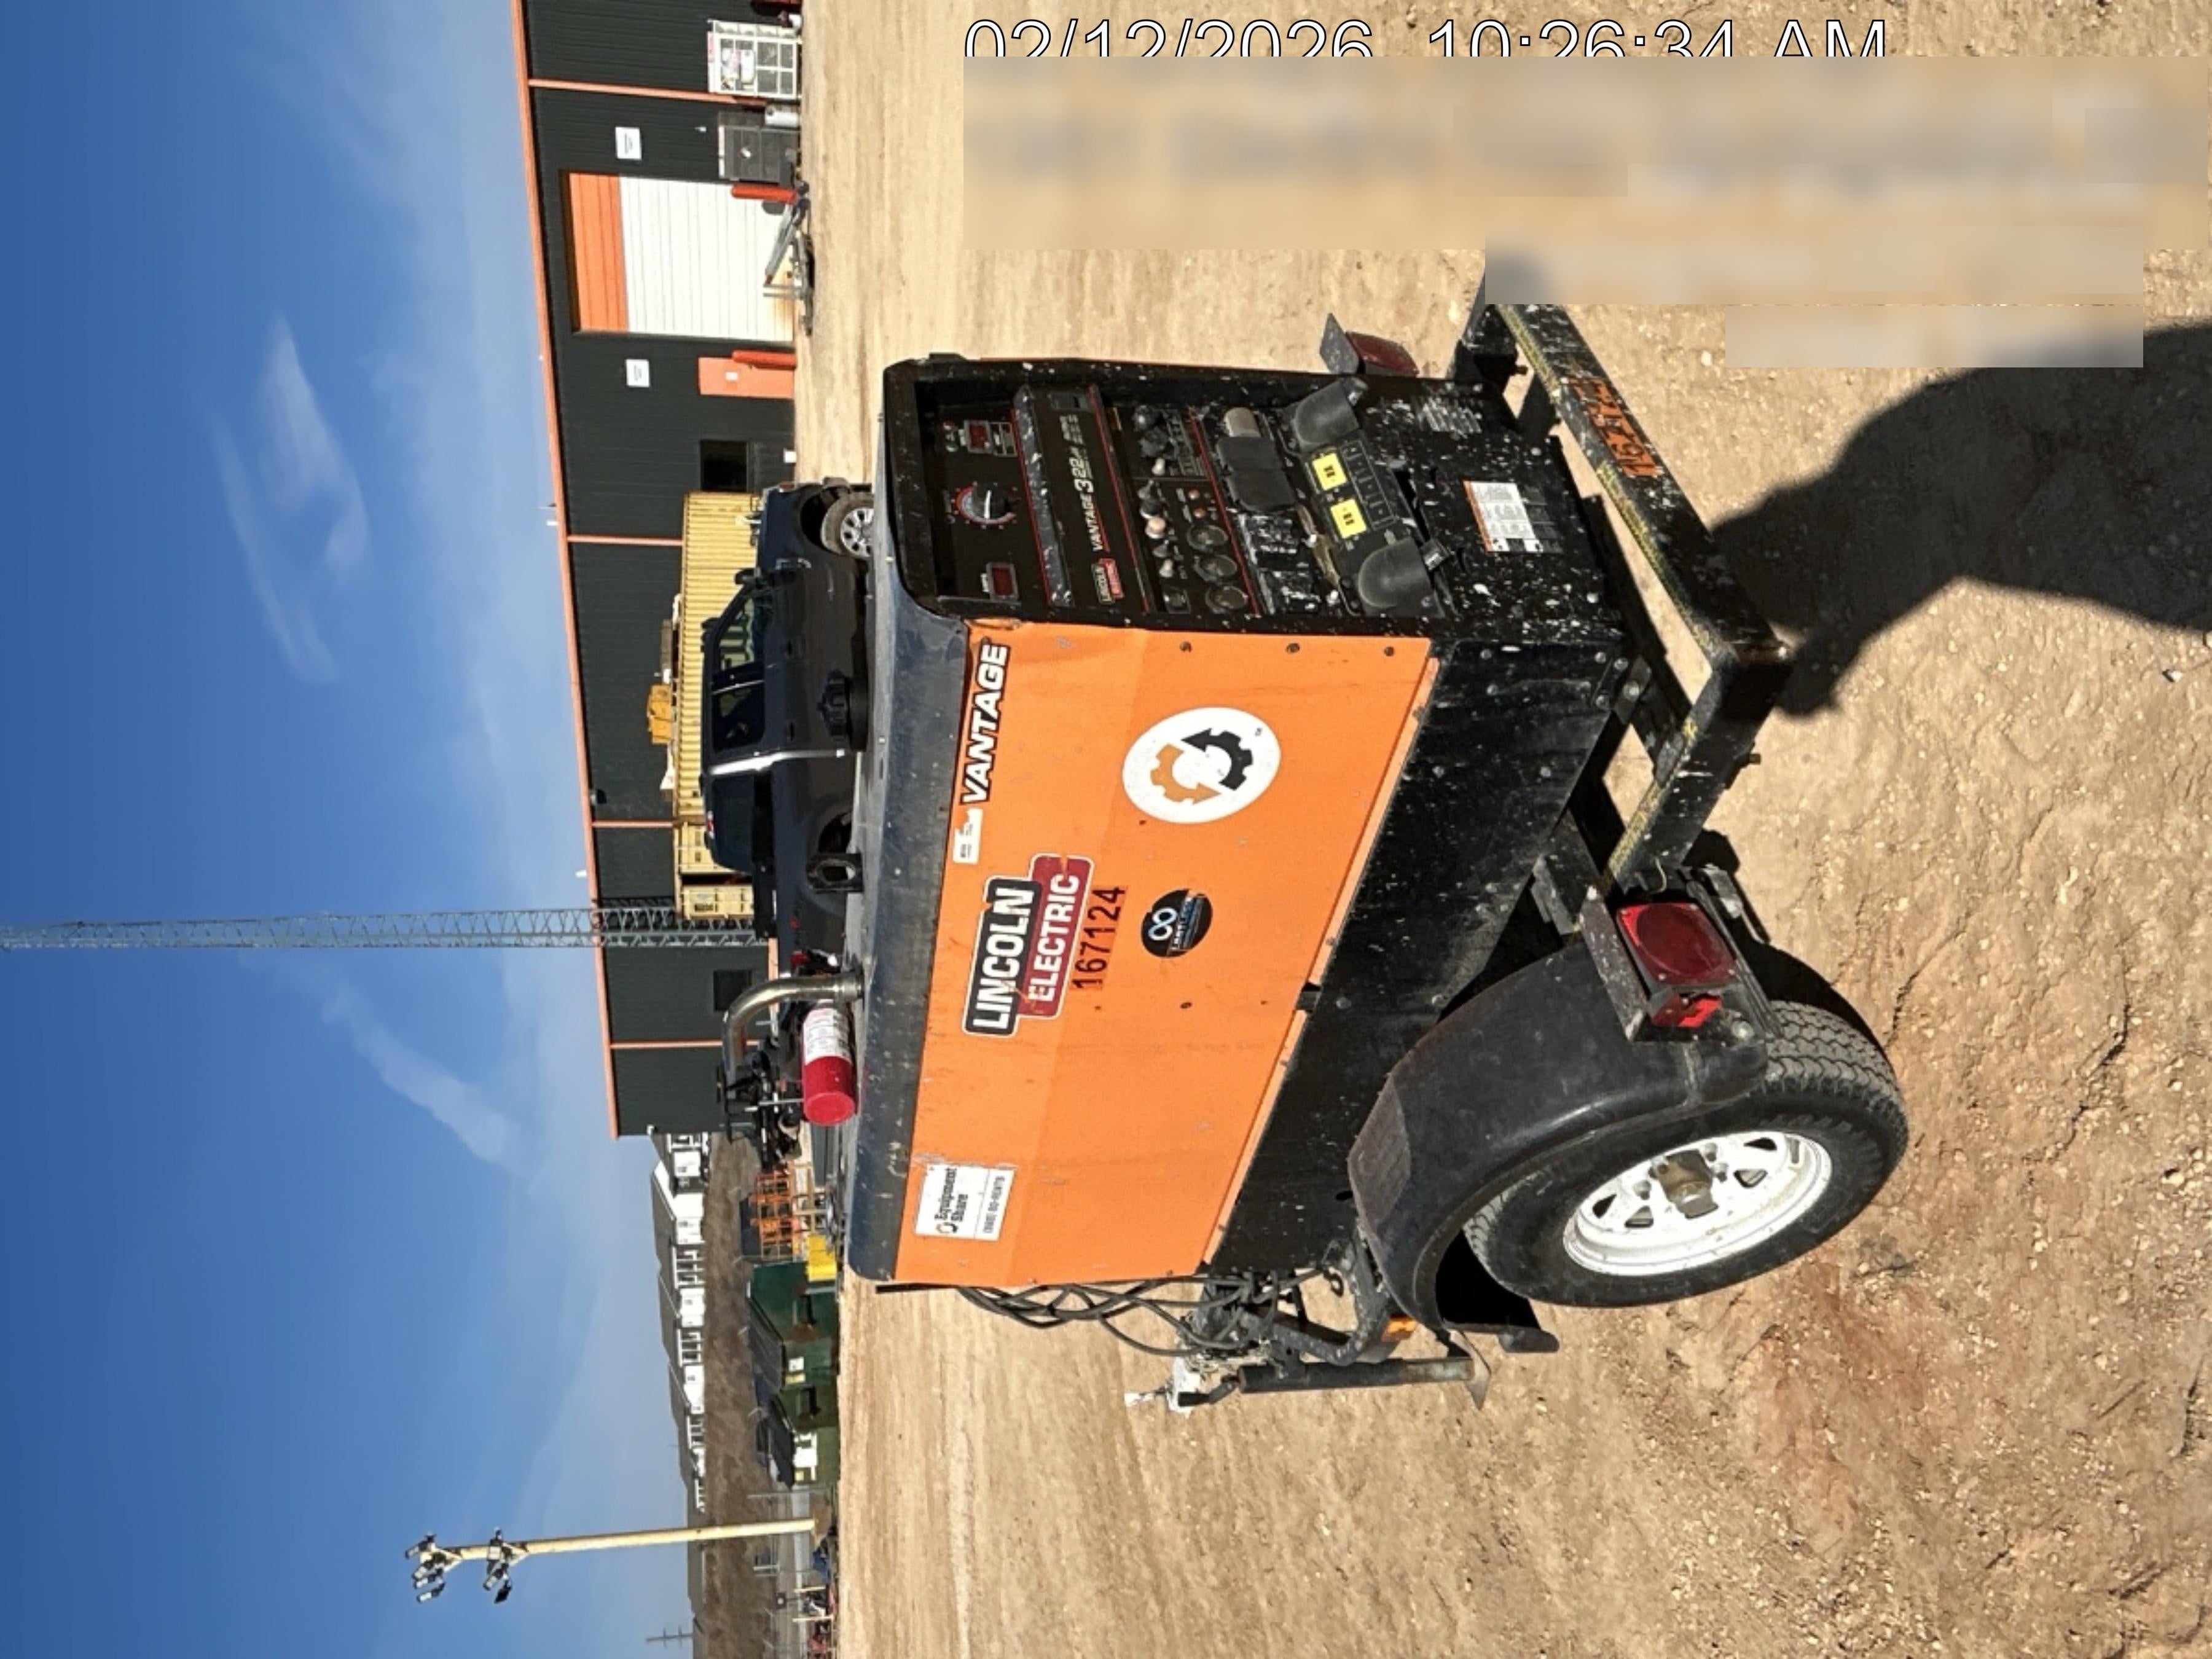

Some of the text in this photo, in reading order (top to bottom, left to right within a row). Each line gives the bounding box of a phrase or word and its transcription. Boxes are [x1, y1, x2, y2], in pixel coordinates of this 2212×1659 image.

[1080, 493, 1104, 551] VANTAGE
[961, 639, 1008, 803] VANTAGE
[972, 887, 1034, 1029] LINCOLN
[1028, 874, 1080, 1002] ELECTRIC
[1071, 887, 1125, 989] 167124
